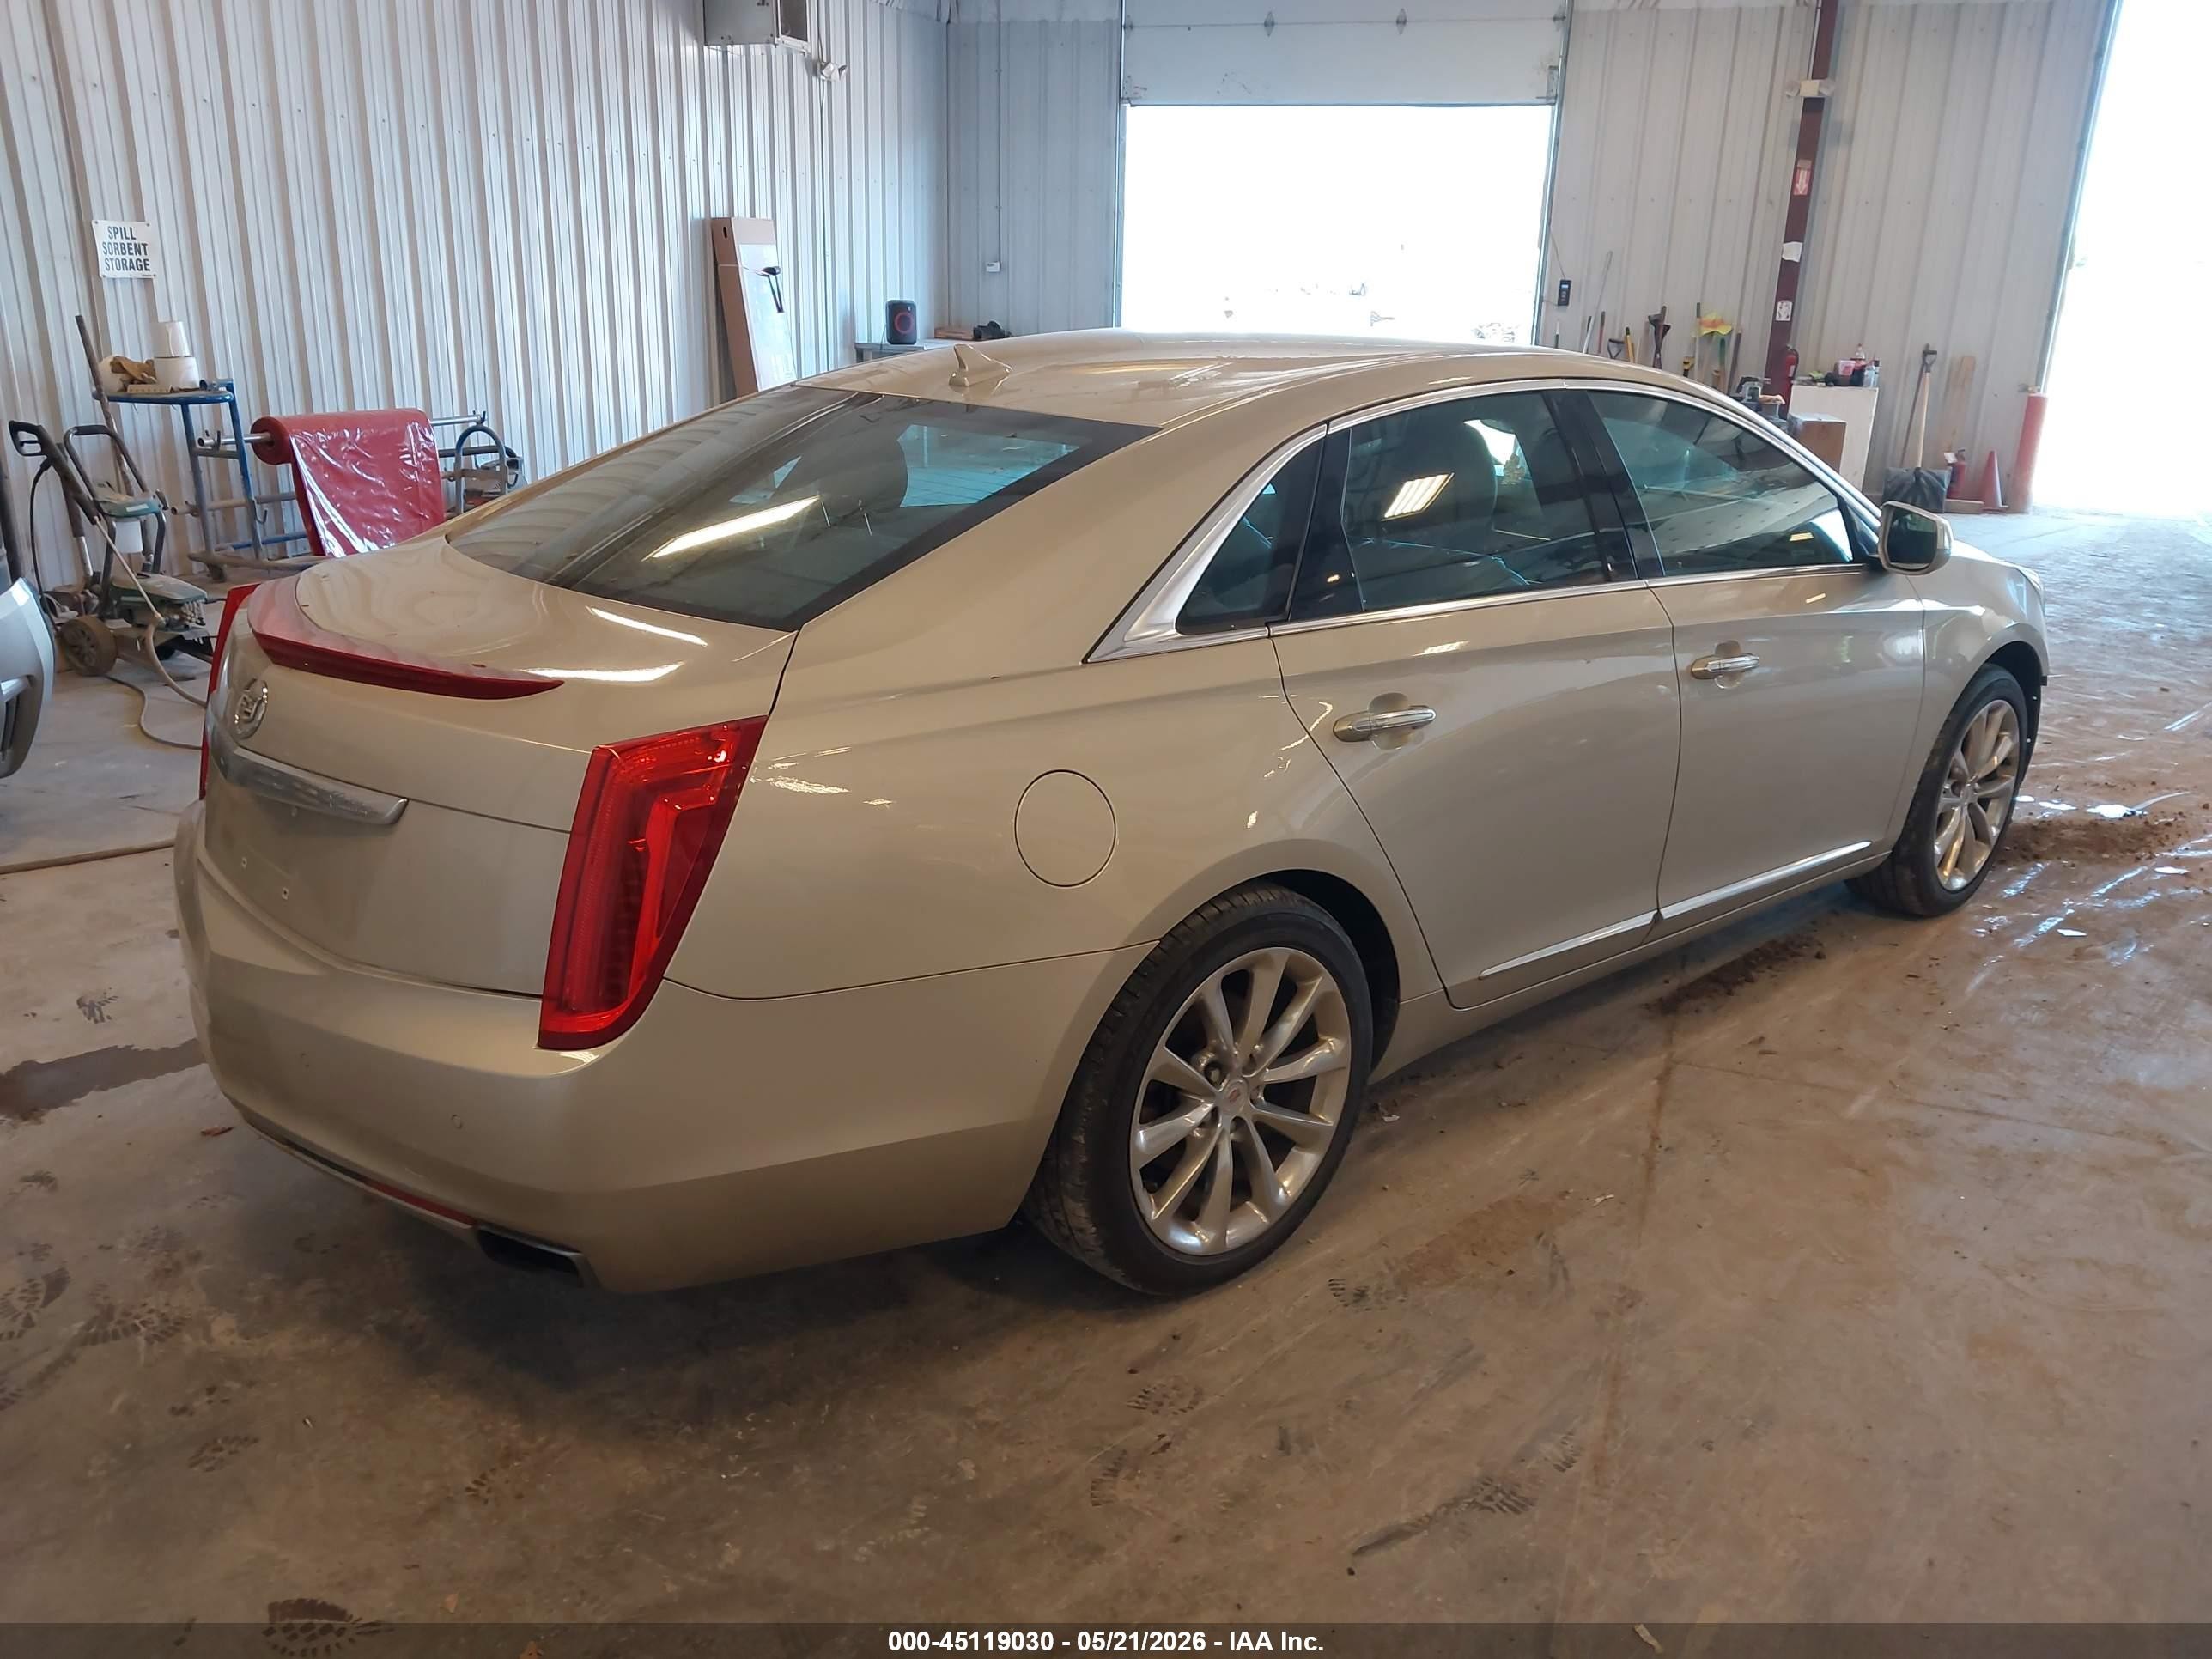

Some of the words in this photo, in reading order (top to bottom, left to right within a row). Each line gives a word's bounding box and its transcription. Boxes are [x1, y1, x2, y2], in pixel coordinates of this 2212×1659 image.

[107, 226, 137, 240] SPILL
[102, 241, 149, 256] SORBENT
[105, 258, 151, 271] STORAGE
